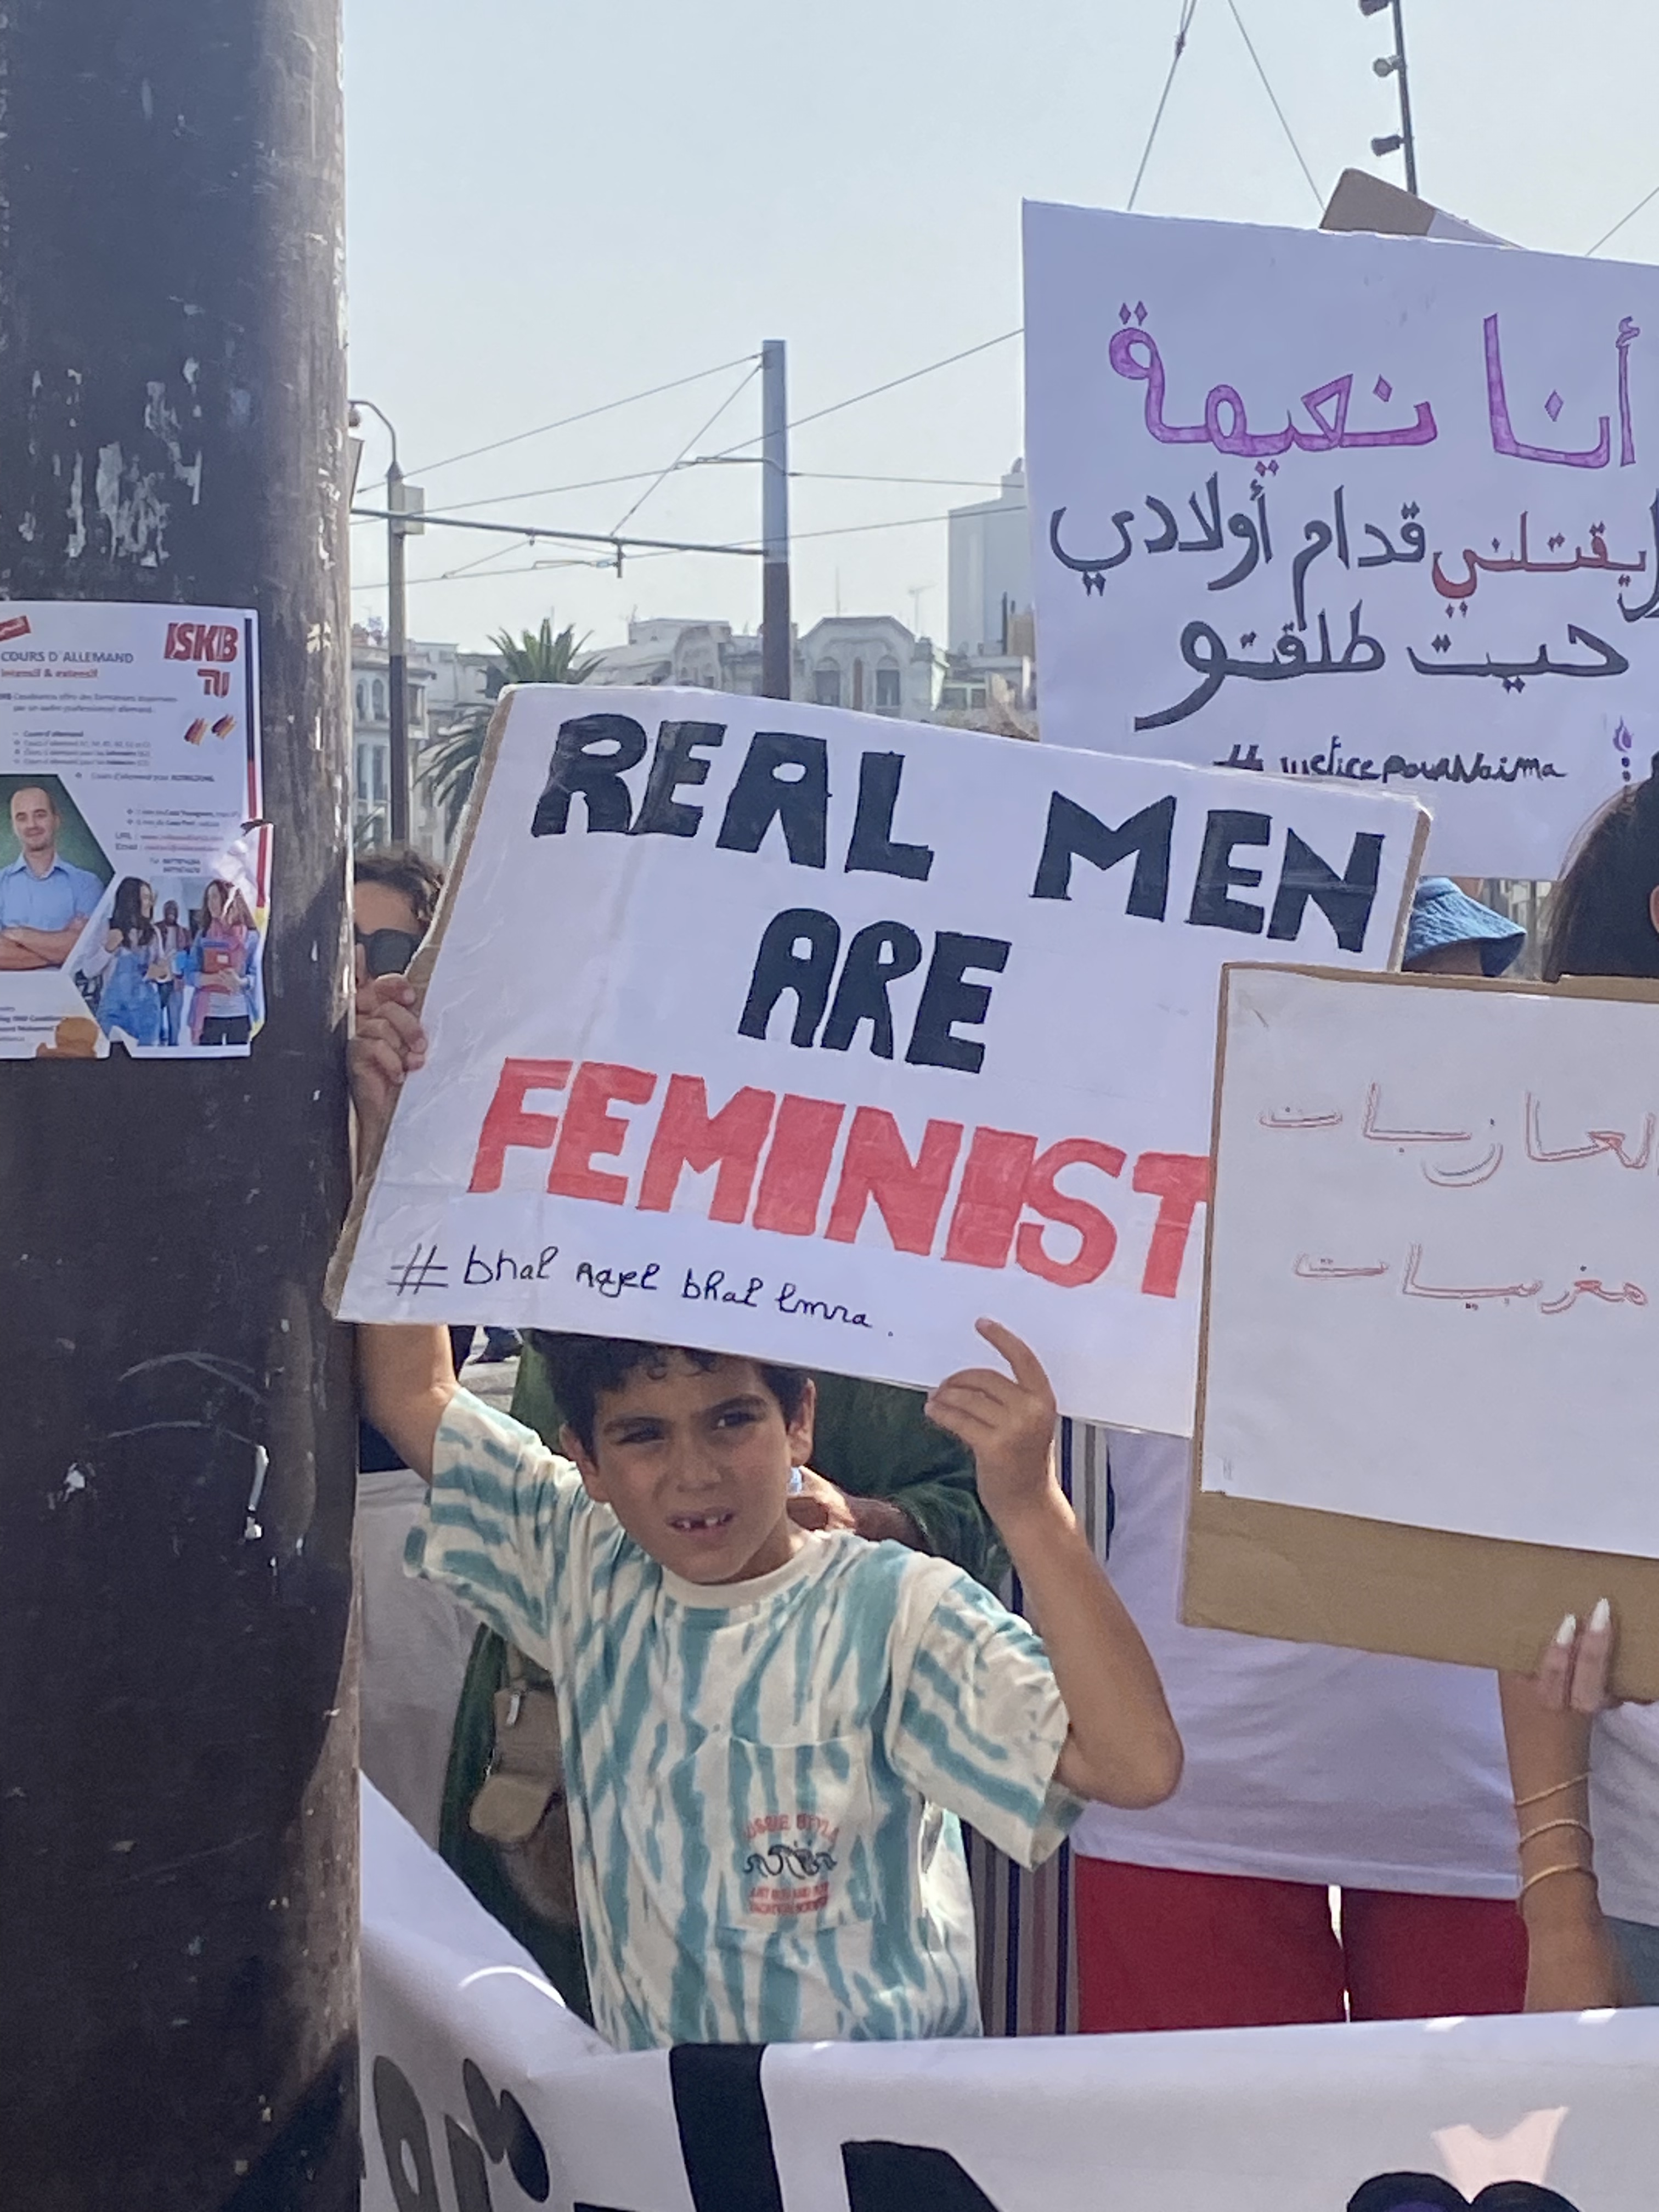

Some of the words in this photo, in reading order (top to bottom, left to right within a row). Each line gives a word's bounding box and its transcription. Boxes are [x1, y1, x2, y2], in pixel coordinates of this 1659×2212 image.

[1109, 301, 1438, 475] نعيمة
[1483, 313, 1640, 469] أنا
[1050, 472, 1273, 596] أولادي
[1293, 485, 1426, 630] قدام
[2, 651, 45, 662] COURS
[164, 622, 238, 662] ISKB
[531, 713, 934, 881] REAL
[1028, 791, 1386, 952] MEN
[737, 908, 1011, 1073] ARE
[467, 1056, 1210, 1298] FEMINIST
